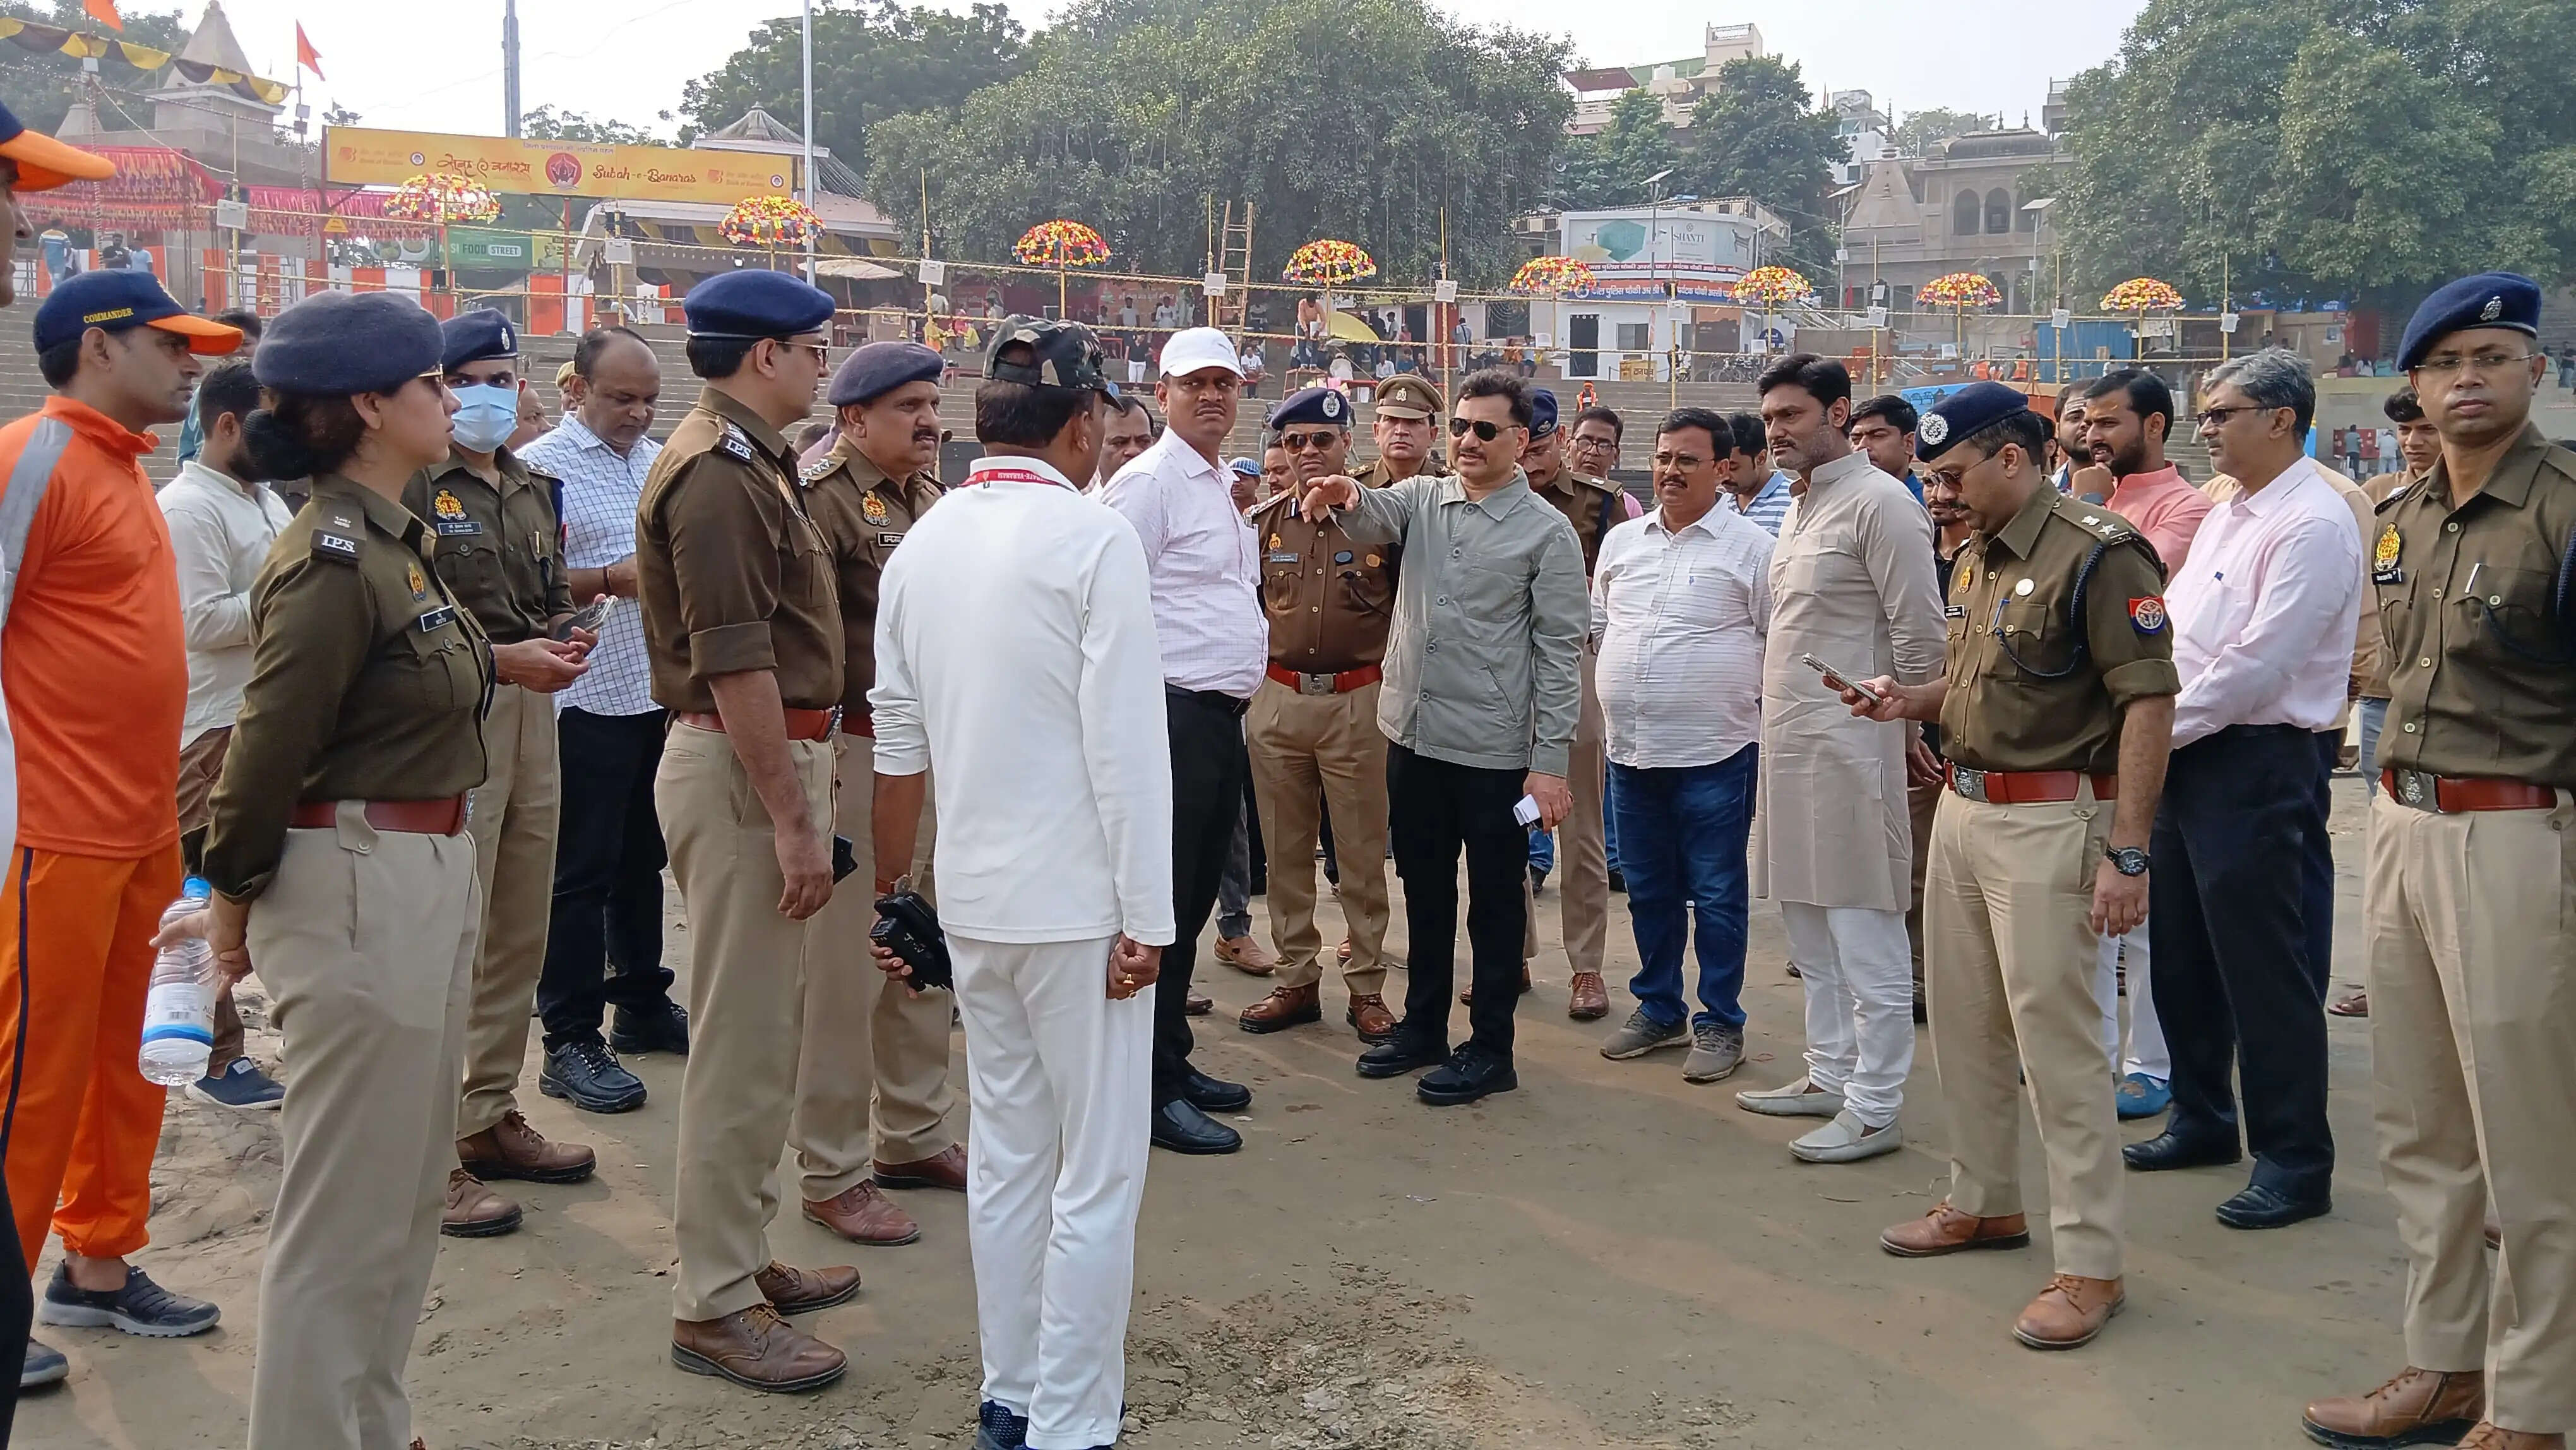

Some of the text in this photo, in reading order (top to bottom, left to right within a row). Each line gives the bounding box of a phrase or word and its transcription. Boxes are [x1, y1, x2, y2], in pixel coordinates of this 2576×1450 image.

[1673, 233, 1705, 243] SHANTI
[462, 243, 487, 255] FOOD
[491, 246, 520, 256] STREET
[1606, 285, 1625, 299] पुलिस
[83, 308, 134, 323] COMMANDER
